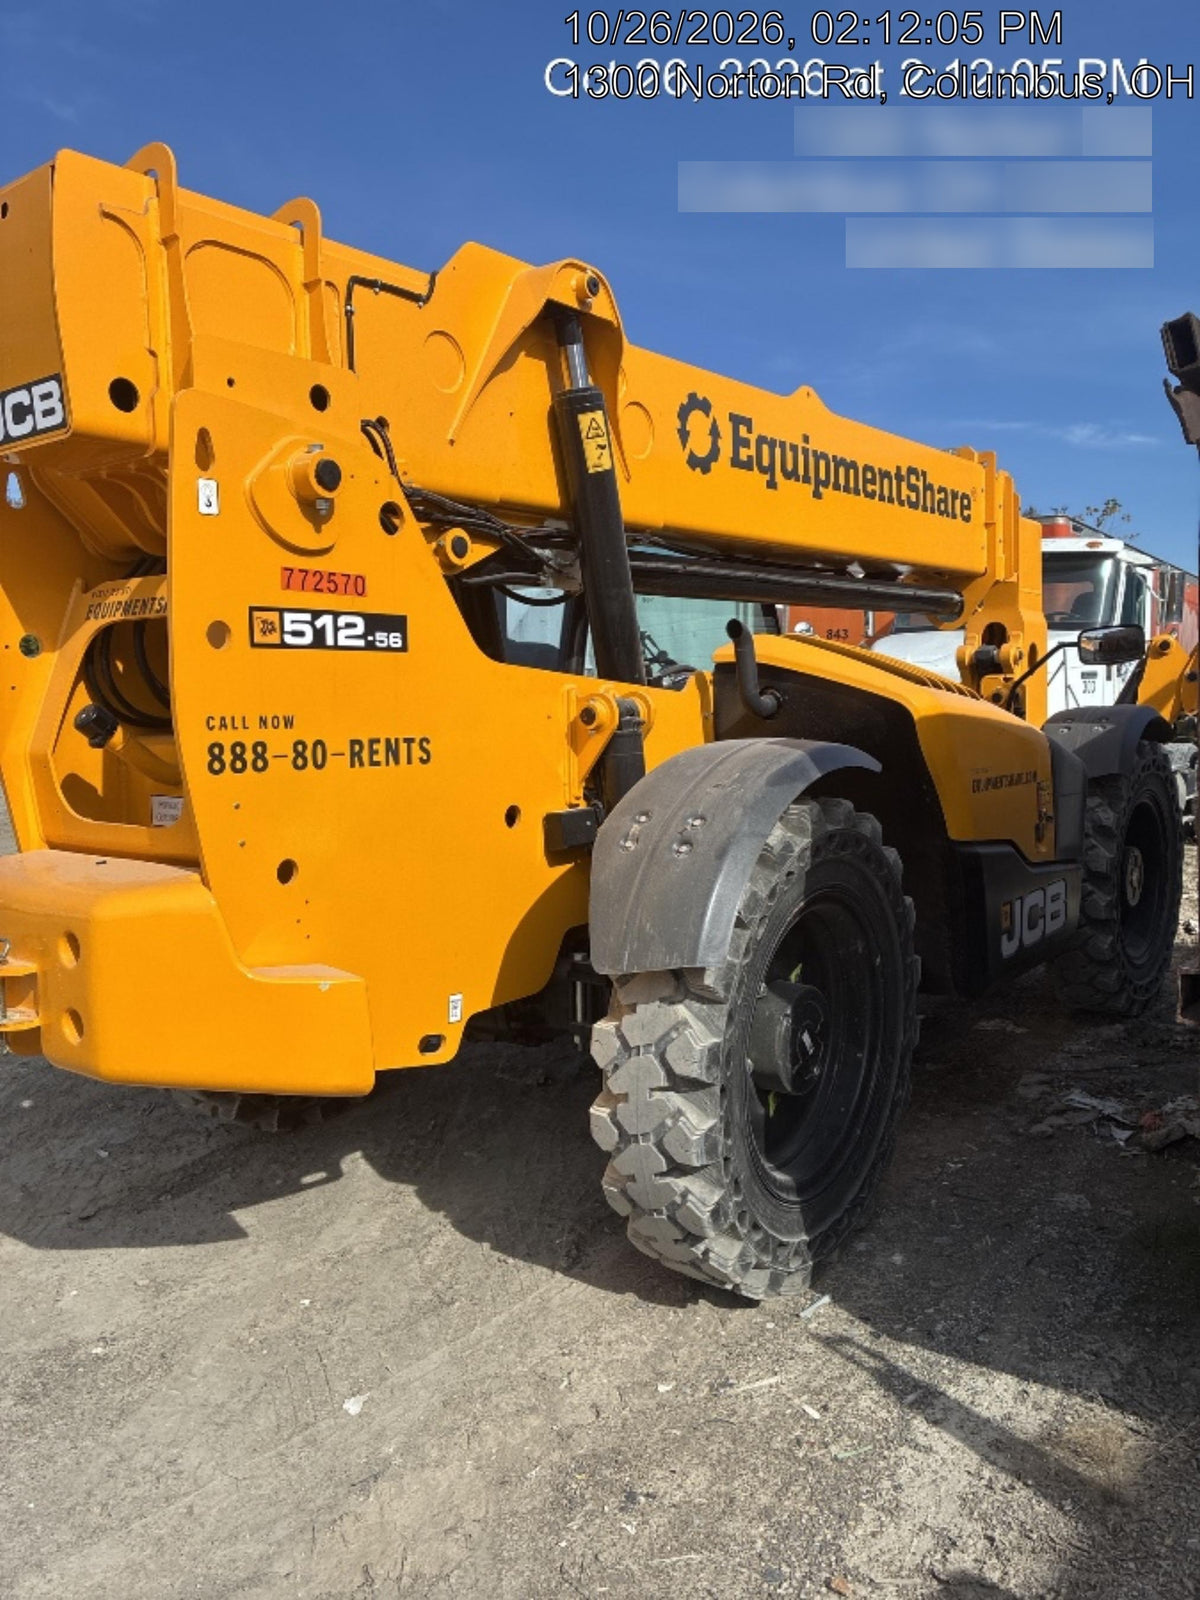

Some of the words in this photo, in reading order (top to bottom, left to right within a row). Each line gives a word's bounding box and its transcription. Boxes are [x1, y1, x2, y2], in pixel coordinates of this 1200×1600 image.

[0, 380, 64, 440] CB
[728, 411, 972, 522] EquipmentShare
[283, 567, 366, 597] 772570
[826, 629, 849, 640] 843
[206, 715, 250, 731] CALL
[258, 715, 295, 730] NOW
[207, 737, 432, 775] 888-80-RENTS
[1001, 879, 1066, 958] JCB
